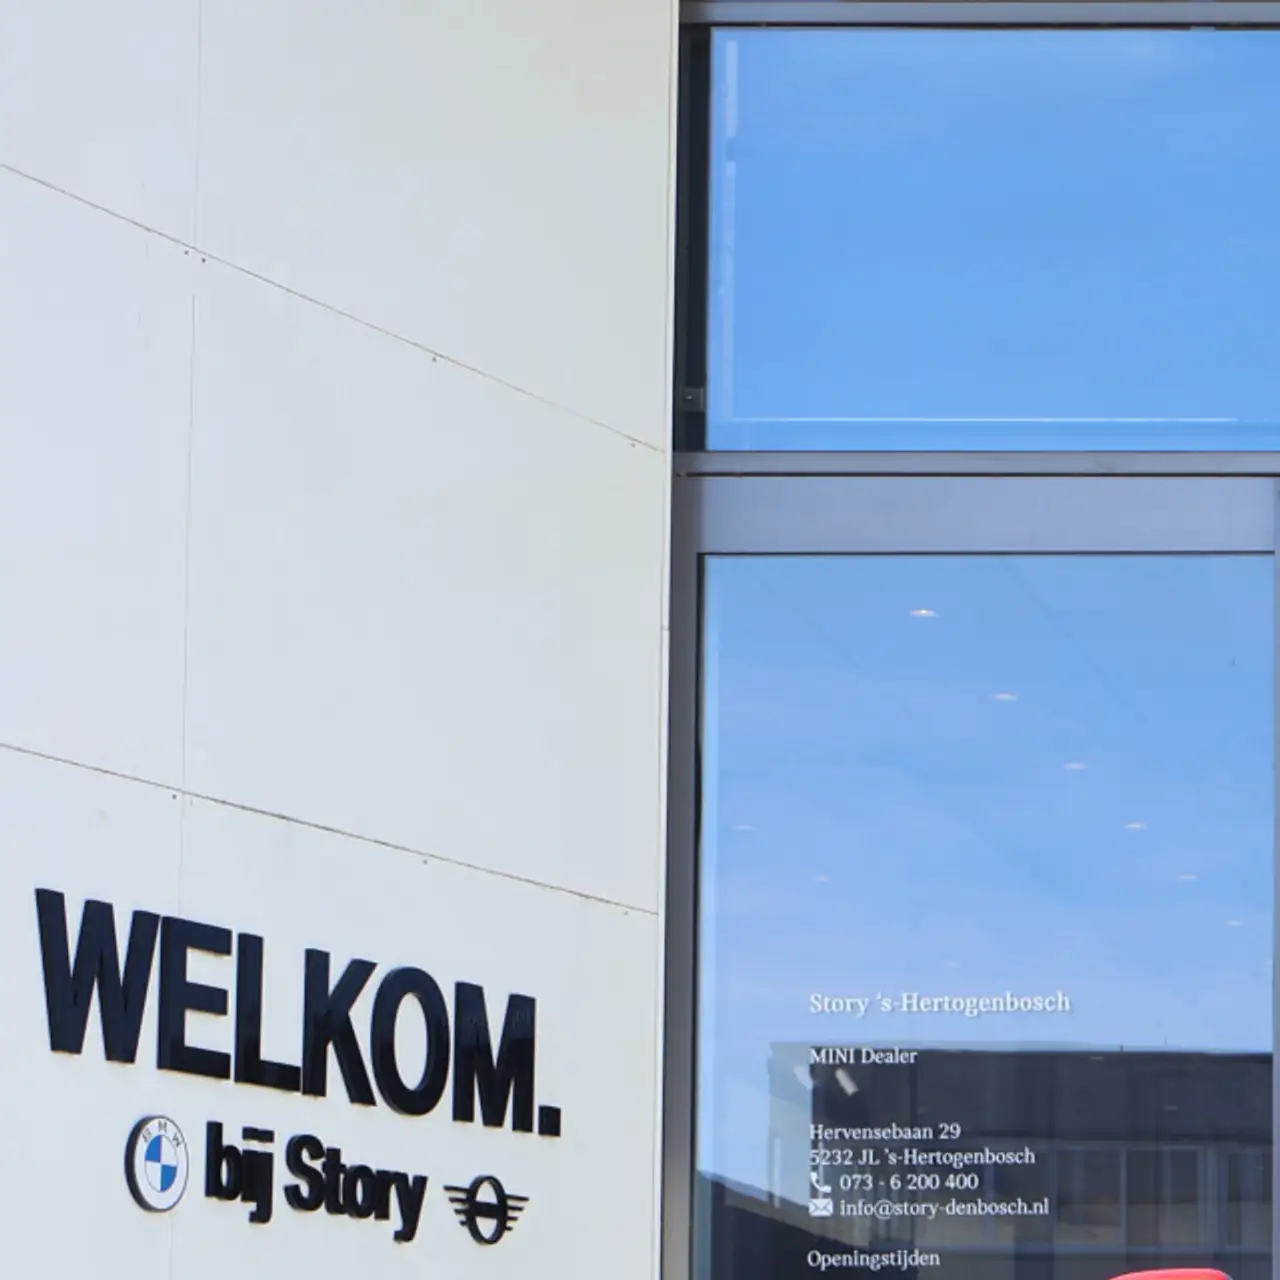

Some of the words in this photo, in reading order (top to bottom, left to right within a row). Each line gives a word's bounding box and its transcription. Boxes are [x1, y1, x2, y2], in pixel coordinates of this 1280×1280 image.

[35, 888, 561, 1137] WELKOM.
[811, 994, 868, 1016] Story
[809, 1048, 855, 1064] MINI
[862, 1049, 916, 1063] Dealer
[809, 1124, 932, 1140] Hervensebaan
[939, 1123, 961, 1139] 29
[809, 1149, 853, 1165] 5232
[858, 1149, 880, 1165] JL
[205, 1121, 274, 1223] bij
[284, 1134, 428, 1242] Story
[840, 1174, 872, 1190] 073
[890, 1174, 901, 1189] 6
[907, 1174, 940, 1189] 200
[945, 1174, 979, 1189] 400
[840, 1198, 1048, 1219] info@story-denbosch.nl
[808, 1250, 939, 1271] Openingstijden
